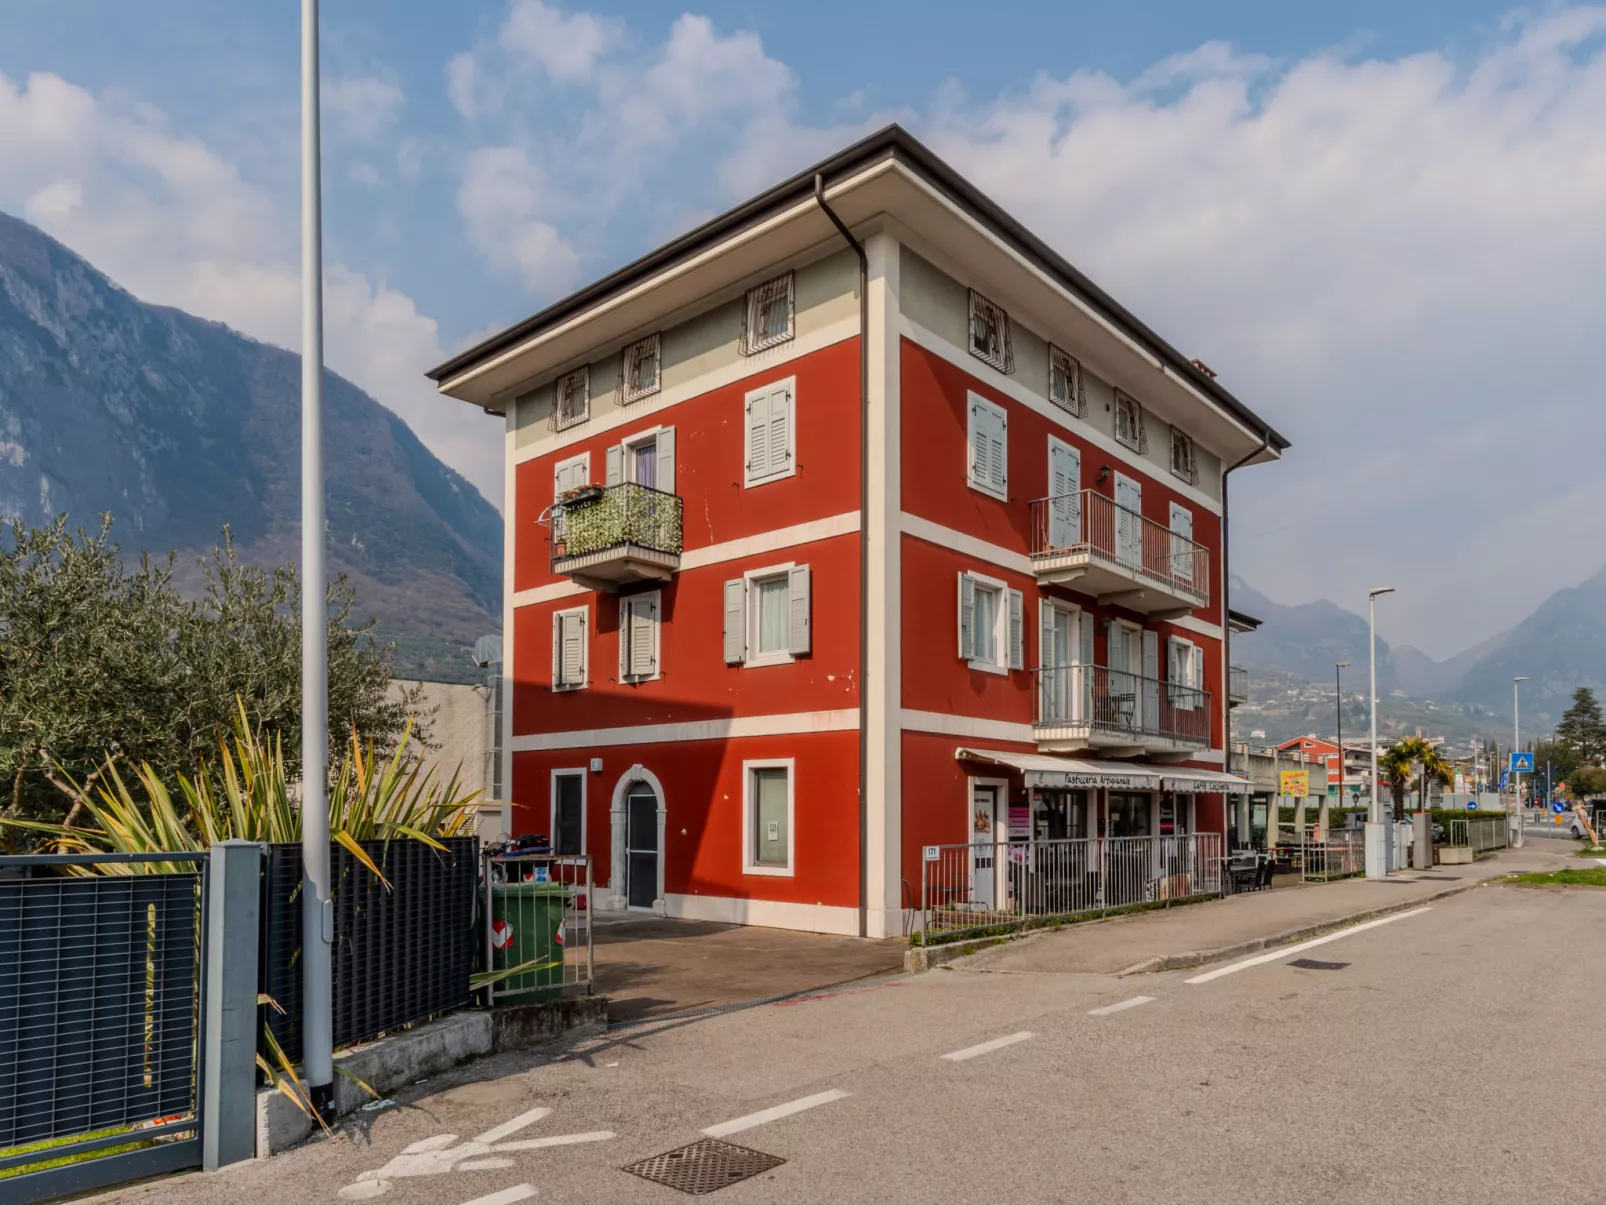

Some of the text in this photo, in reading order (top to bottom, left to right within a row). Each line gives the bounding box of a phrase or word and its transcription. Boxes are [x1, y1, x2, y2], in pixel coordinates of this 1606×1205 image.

[1064, 773, 1131, 786] Pasticceria Artigianale
[928, 847, 936, 856] 171
